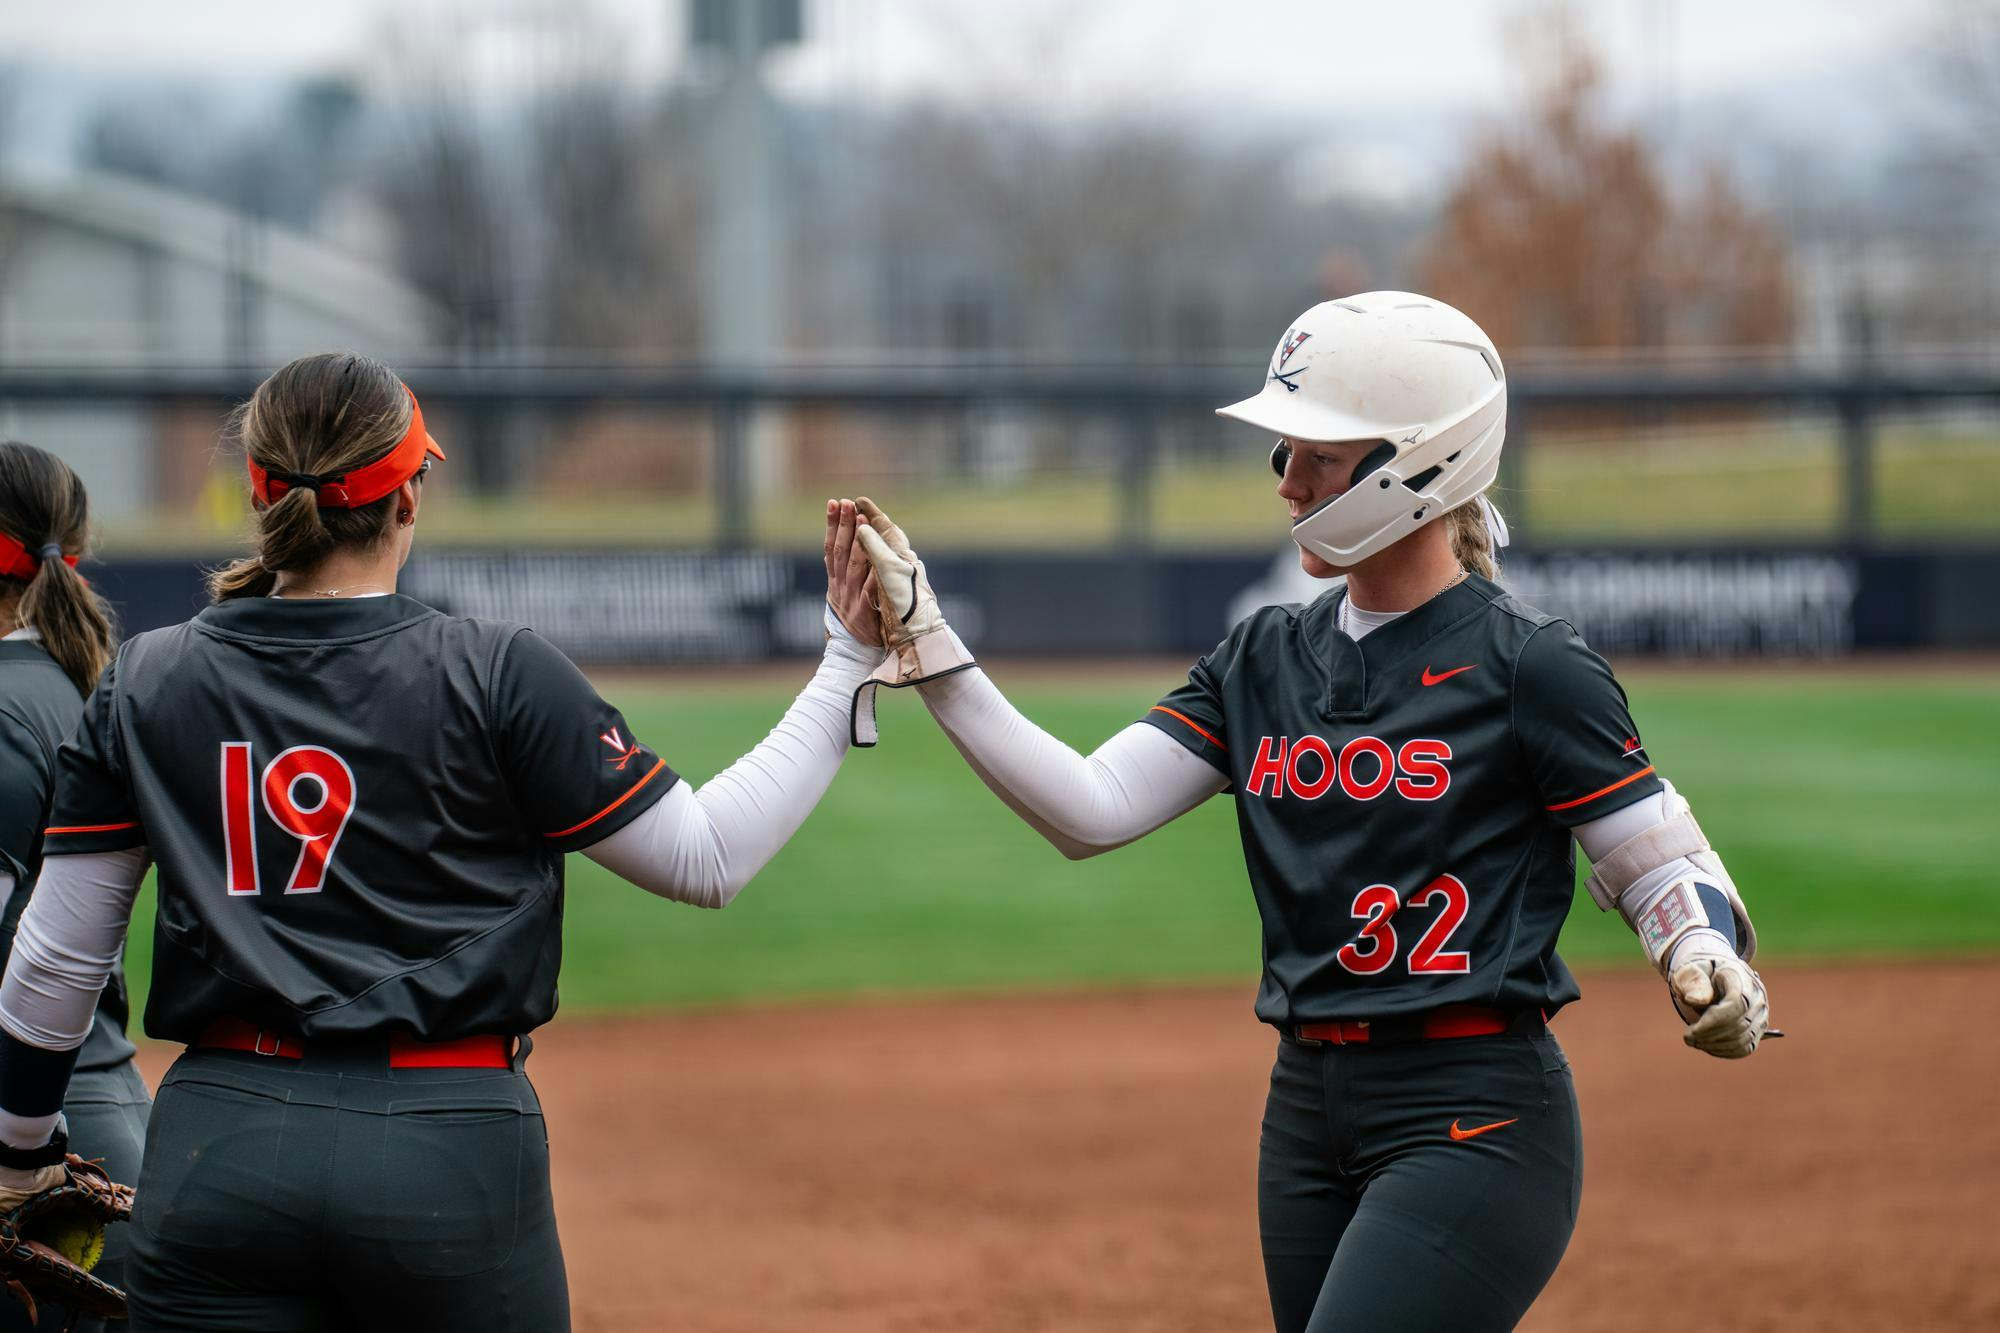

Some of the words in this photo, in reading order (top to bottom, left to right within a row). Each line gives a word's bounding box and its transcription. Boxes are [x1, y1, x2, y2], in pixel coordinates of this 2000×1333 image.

[220, 741, 357, 896] 19
[1246, 735, 1453, 801] HOOS
[1337, 873, 1471, 975] 32
